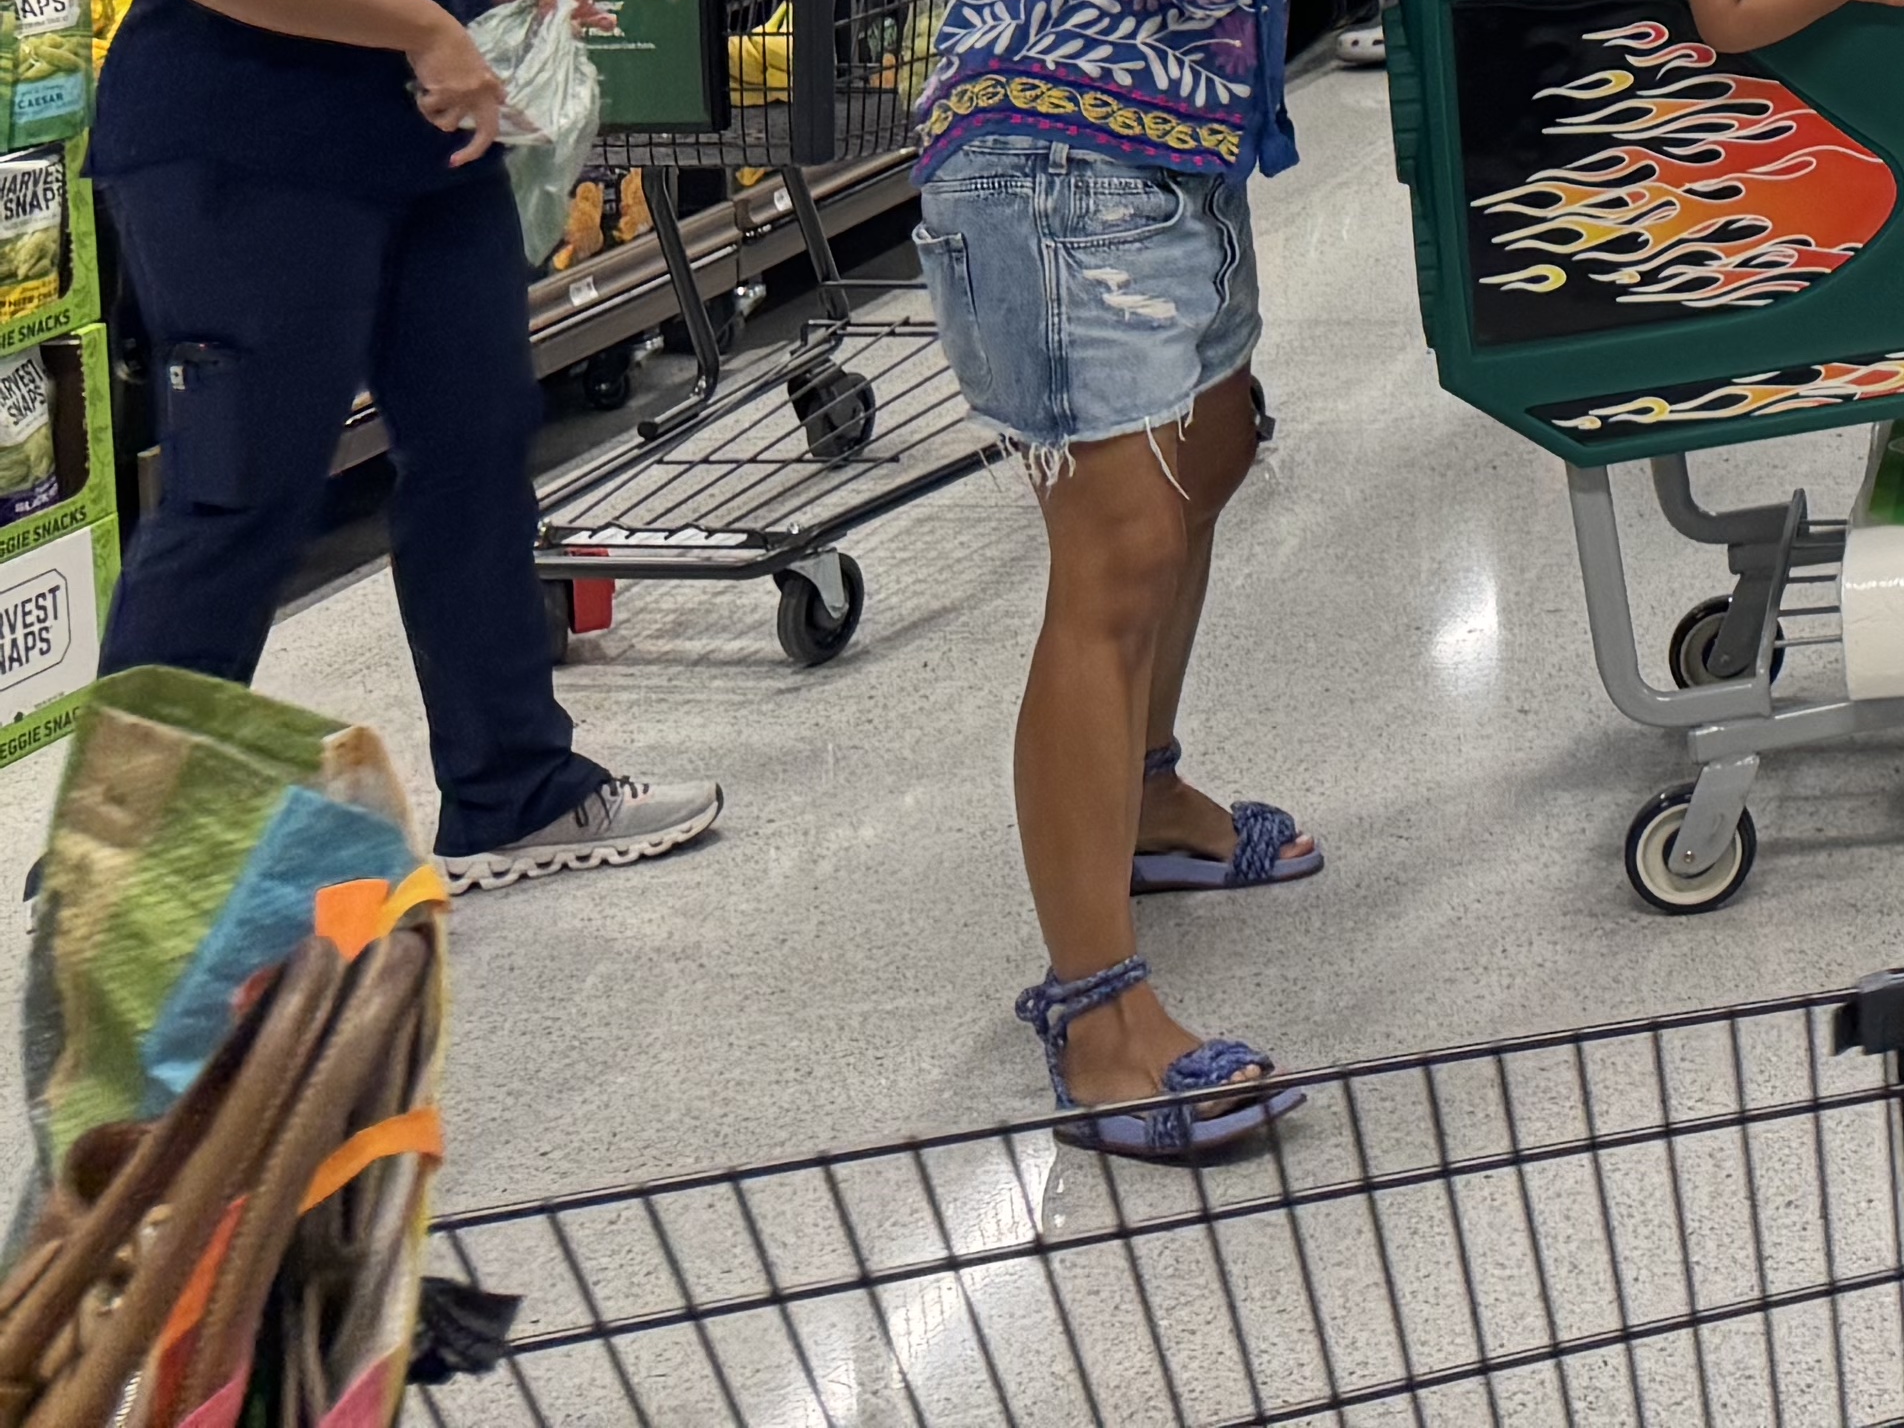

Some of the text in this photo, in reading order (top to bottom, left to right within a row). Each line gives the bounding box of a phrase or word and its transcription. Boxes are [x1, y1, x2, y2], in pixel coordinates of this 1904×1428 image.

[18, 93, 65, 110] CAESAR
[19, 308, 71, 342] SNACKS
[8, 383, 47, 426] SNAPS
[33, 505, 87, 542] SNACKS
